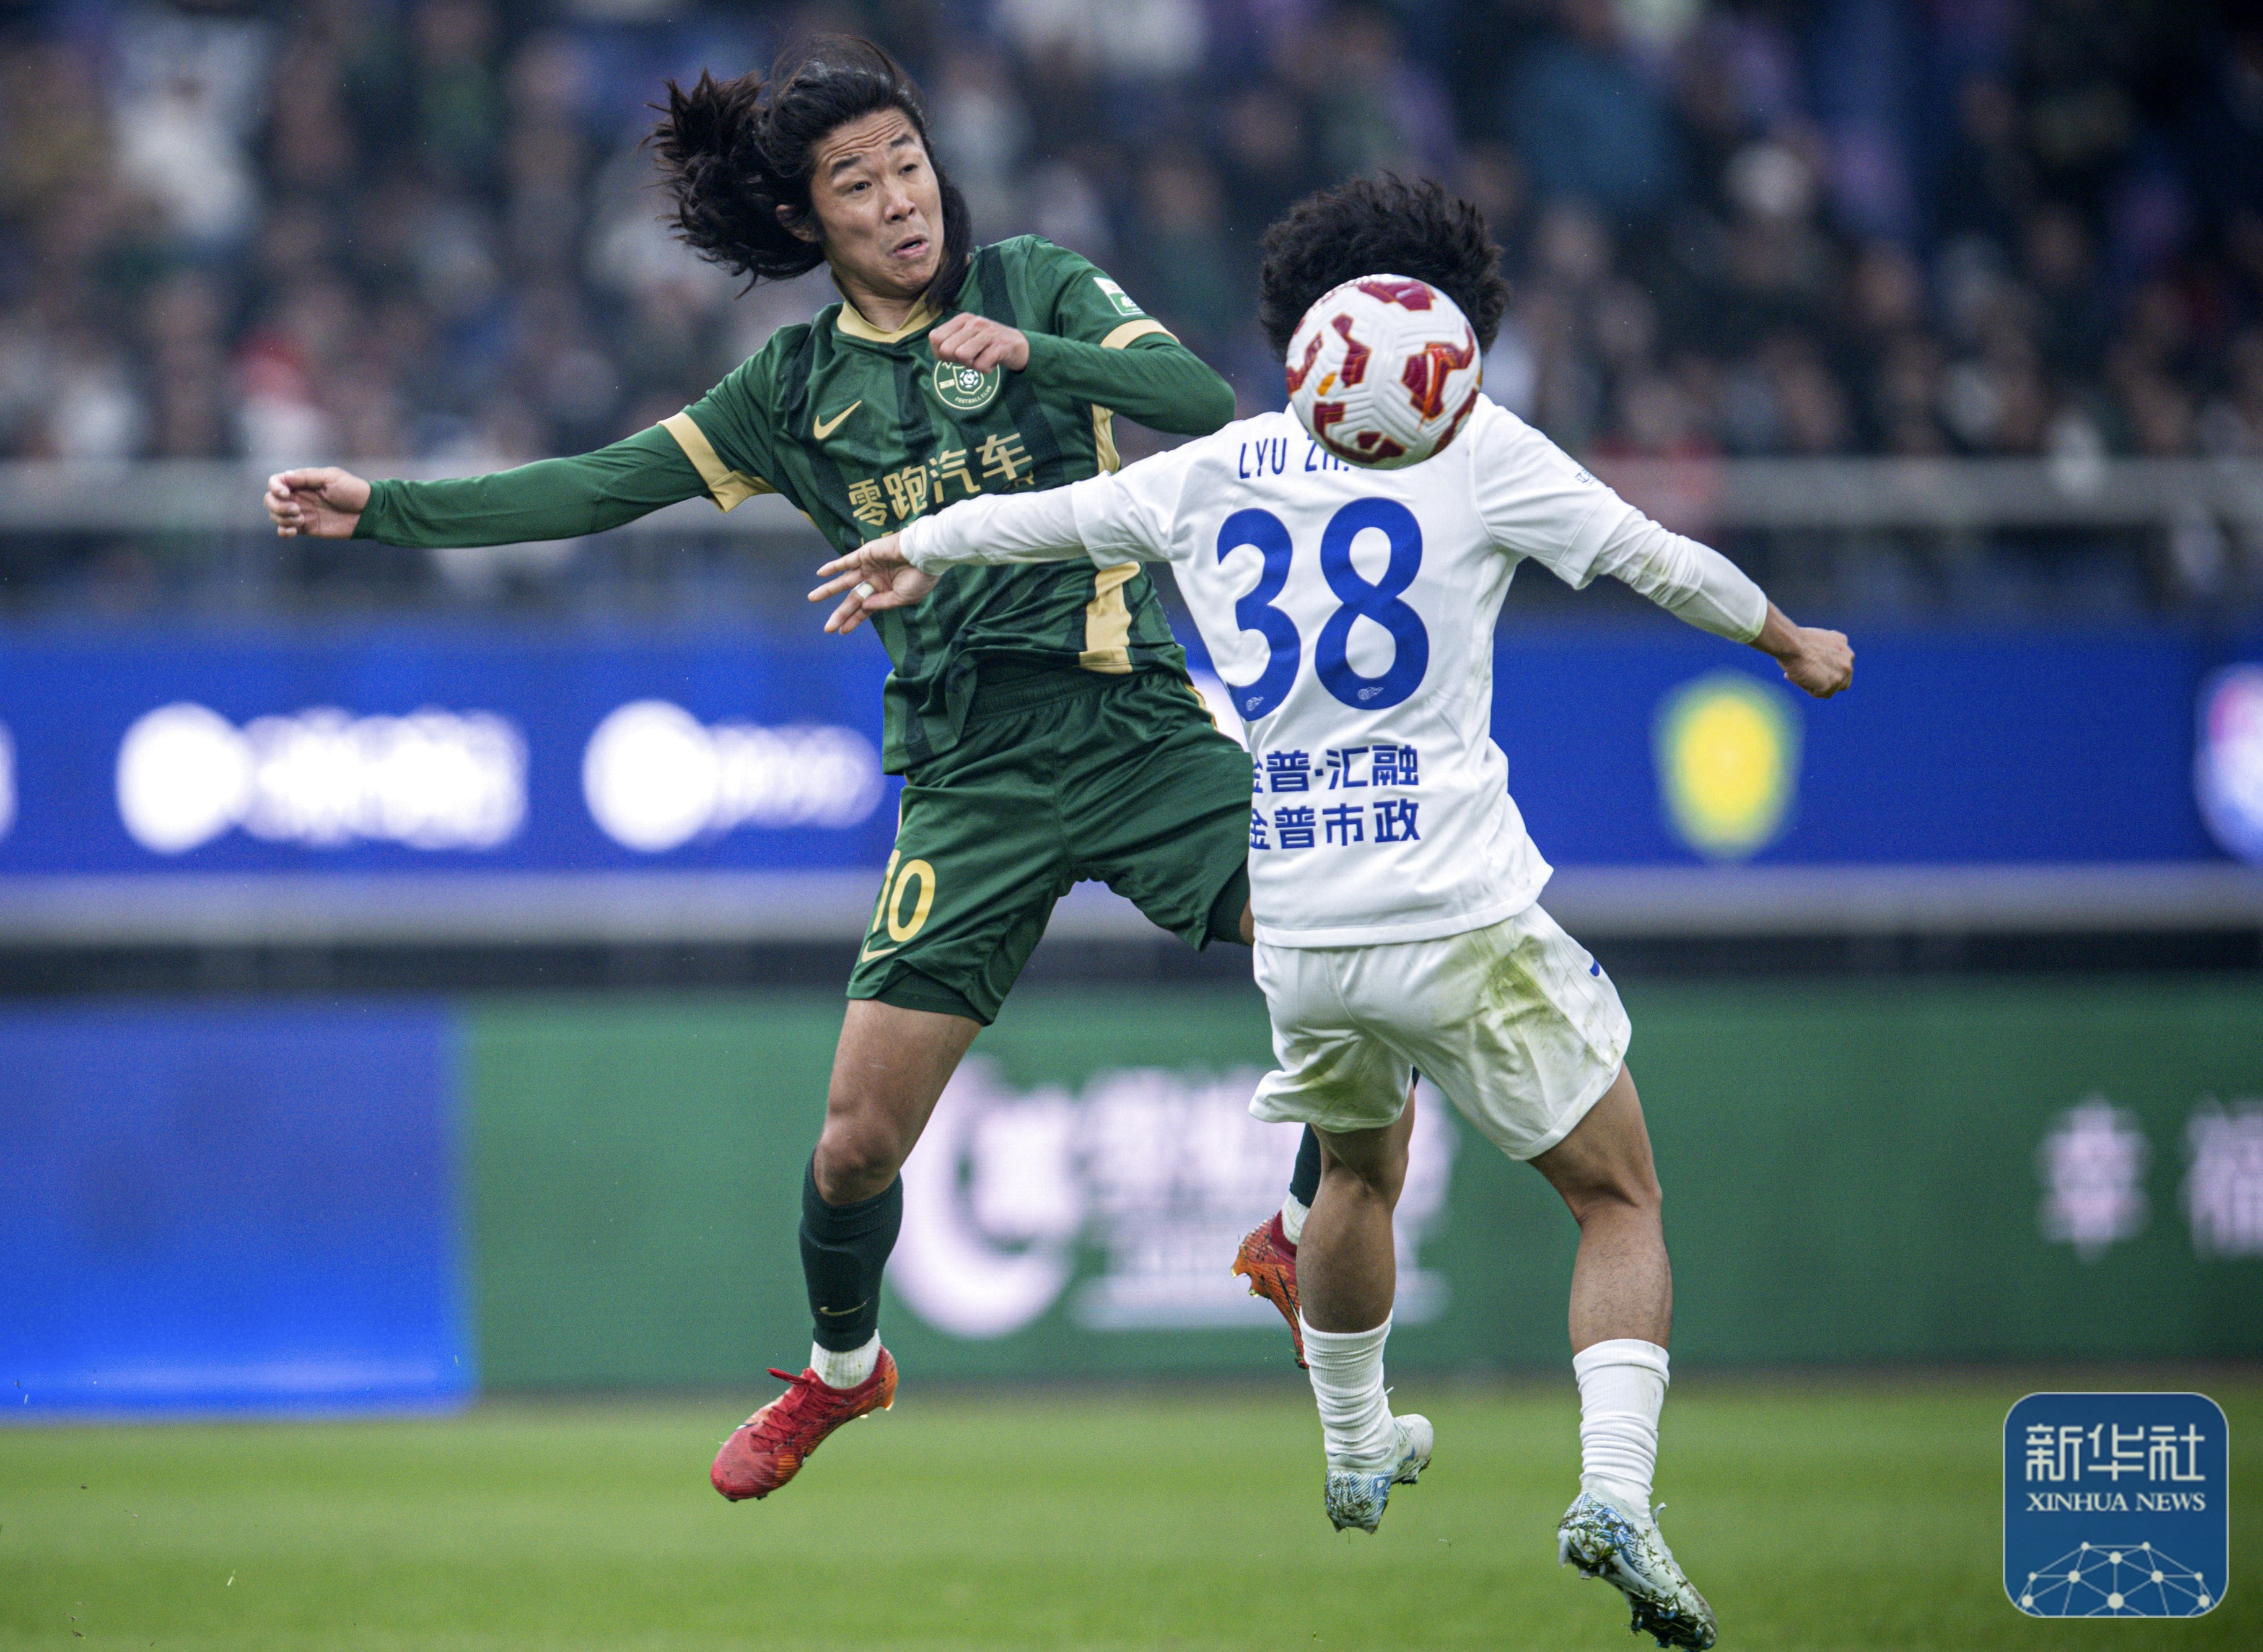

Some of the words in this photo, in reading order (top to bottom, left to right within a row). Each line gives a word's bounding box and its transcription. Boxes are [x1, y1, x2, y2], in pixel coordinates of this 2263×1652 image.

[849, 432, 1033, 526] 零跑汽车
[1240, 437, 1287, 479] LYU
[1217, 497, 1429, 721] 38
[872, 849, 936, 942] 10
